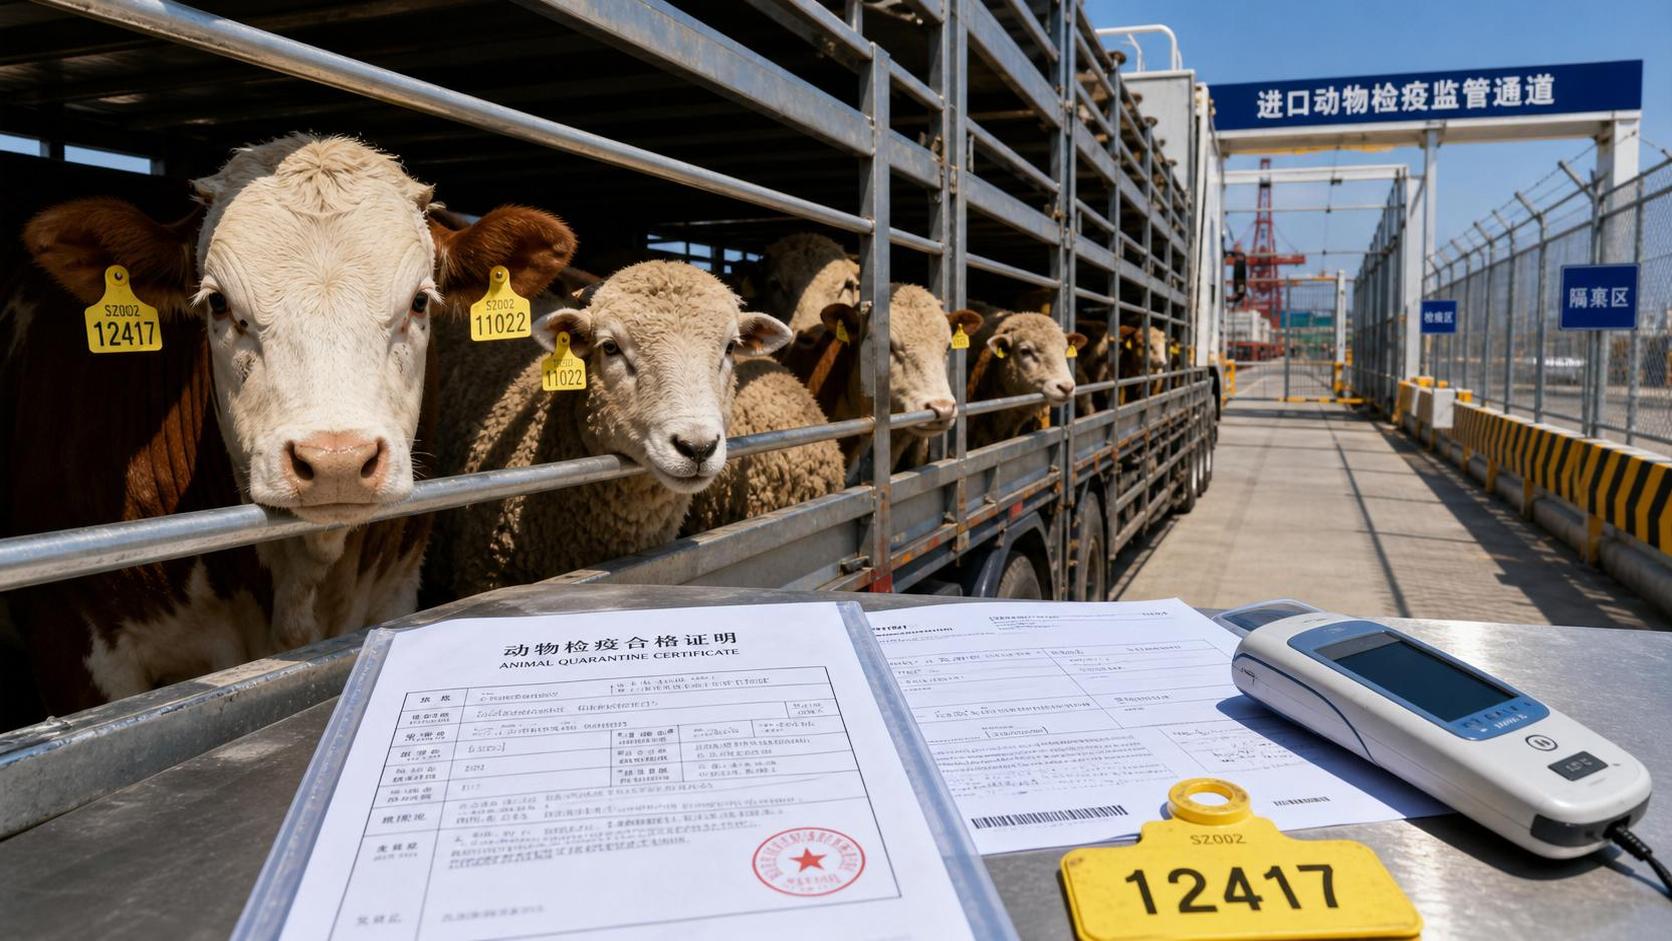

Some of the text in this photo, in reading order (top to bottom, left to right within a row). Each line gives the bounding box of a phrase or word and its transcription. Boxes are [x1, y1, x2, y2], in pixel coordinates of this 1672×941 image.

[1257, 73, 1555, 119] 进口动物检疫监管通道
[93, 320, 155, 347] 12417
[475, 312, 526, 336] 11022
[546, 369, 583, 387] 11022
[503, 632, 737, 657] 动物检疫合格证明
[499, 648, 741, 670] ANIMAL QUARANTINE CERTIFICATE
[1125, 864, 1339, 915] 12417
